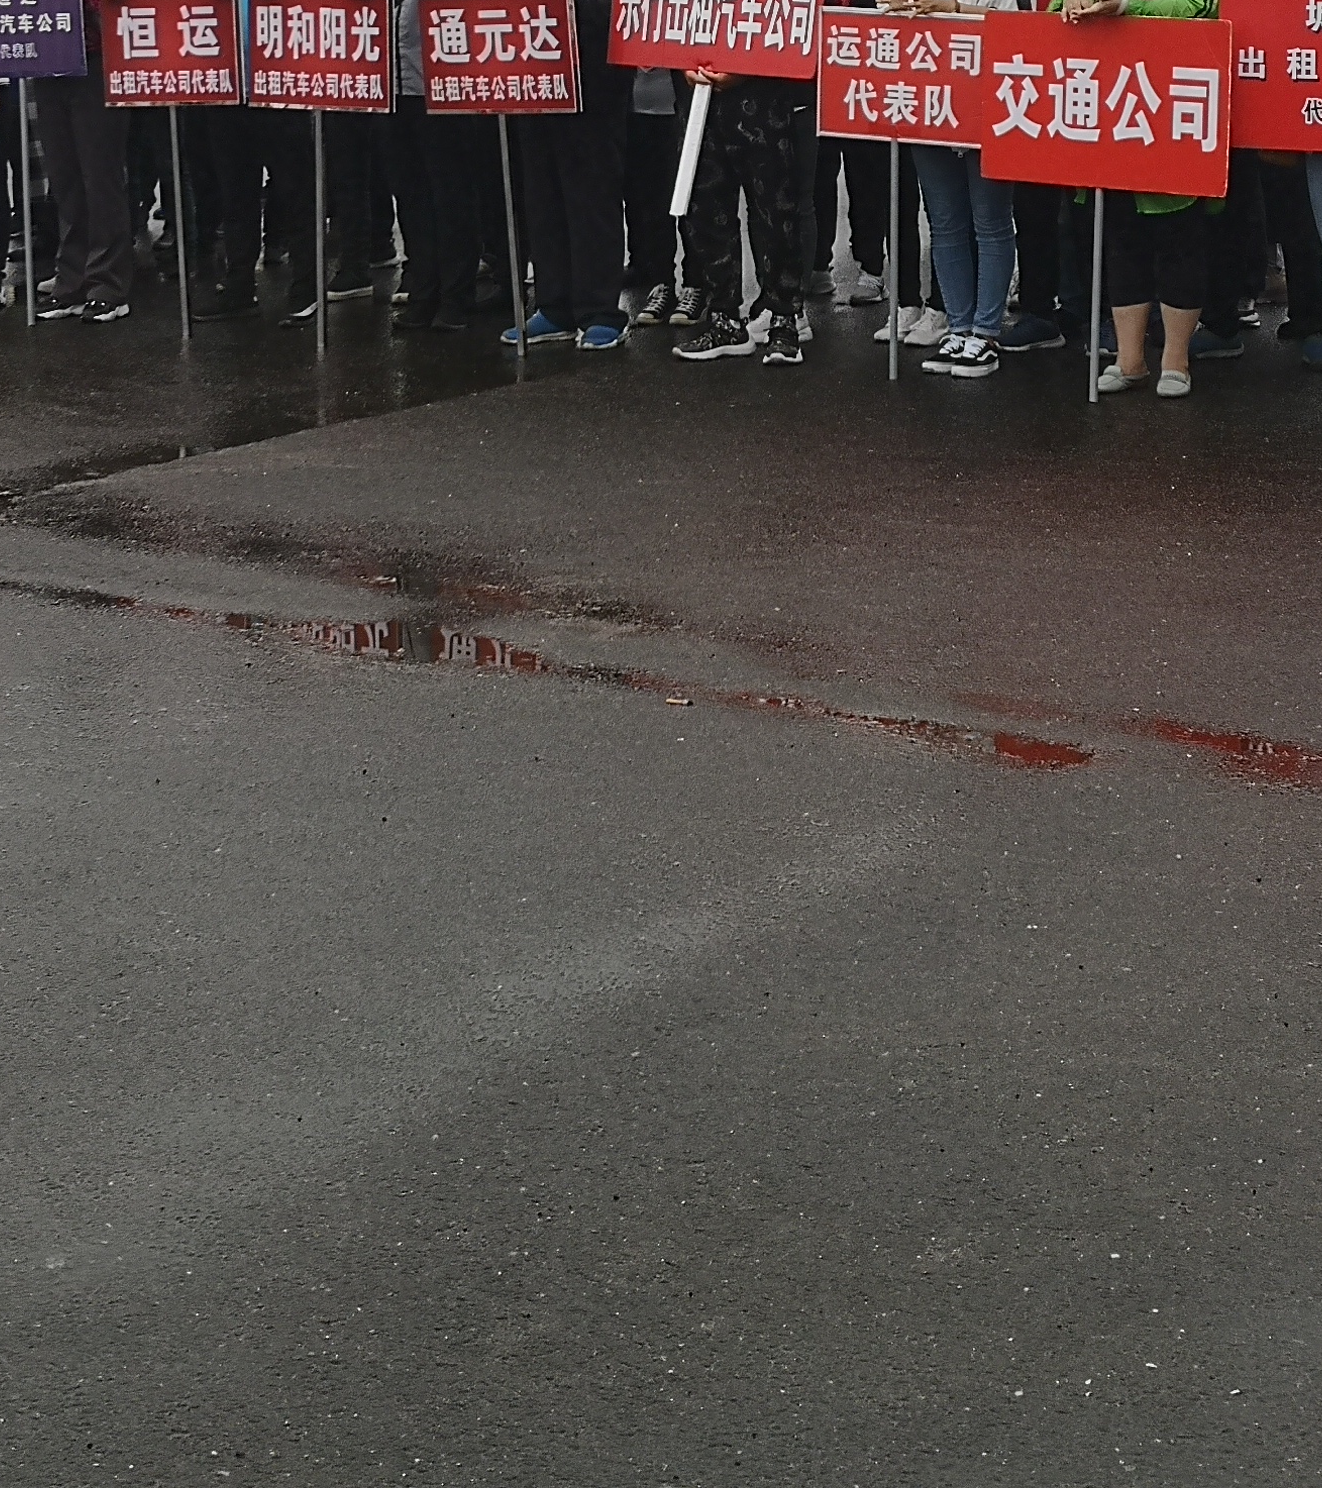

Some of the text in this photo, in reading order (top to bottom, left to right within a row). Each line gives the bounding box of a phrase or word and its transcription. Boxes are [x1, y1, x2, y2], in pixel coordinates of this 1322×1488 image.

[0, 43, 38, 60] 代表队
[117, 5, 221, 60] 恒运
[256, 5, 381, 62] 明和阳光
[428, 5, 563, 64] 通元达
[827, 24, 982, 76] 运通公司
[109, 69, 234, 95] 出租汽车公司代表队
[253, 70, 385, 101] 出租汽车公司代表队
[430, 74, 570, 103] 出租汽车公司代表队
[843, 78, 960, 129] 代表队
[992, 53, 1220, 153] 交通公司
